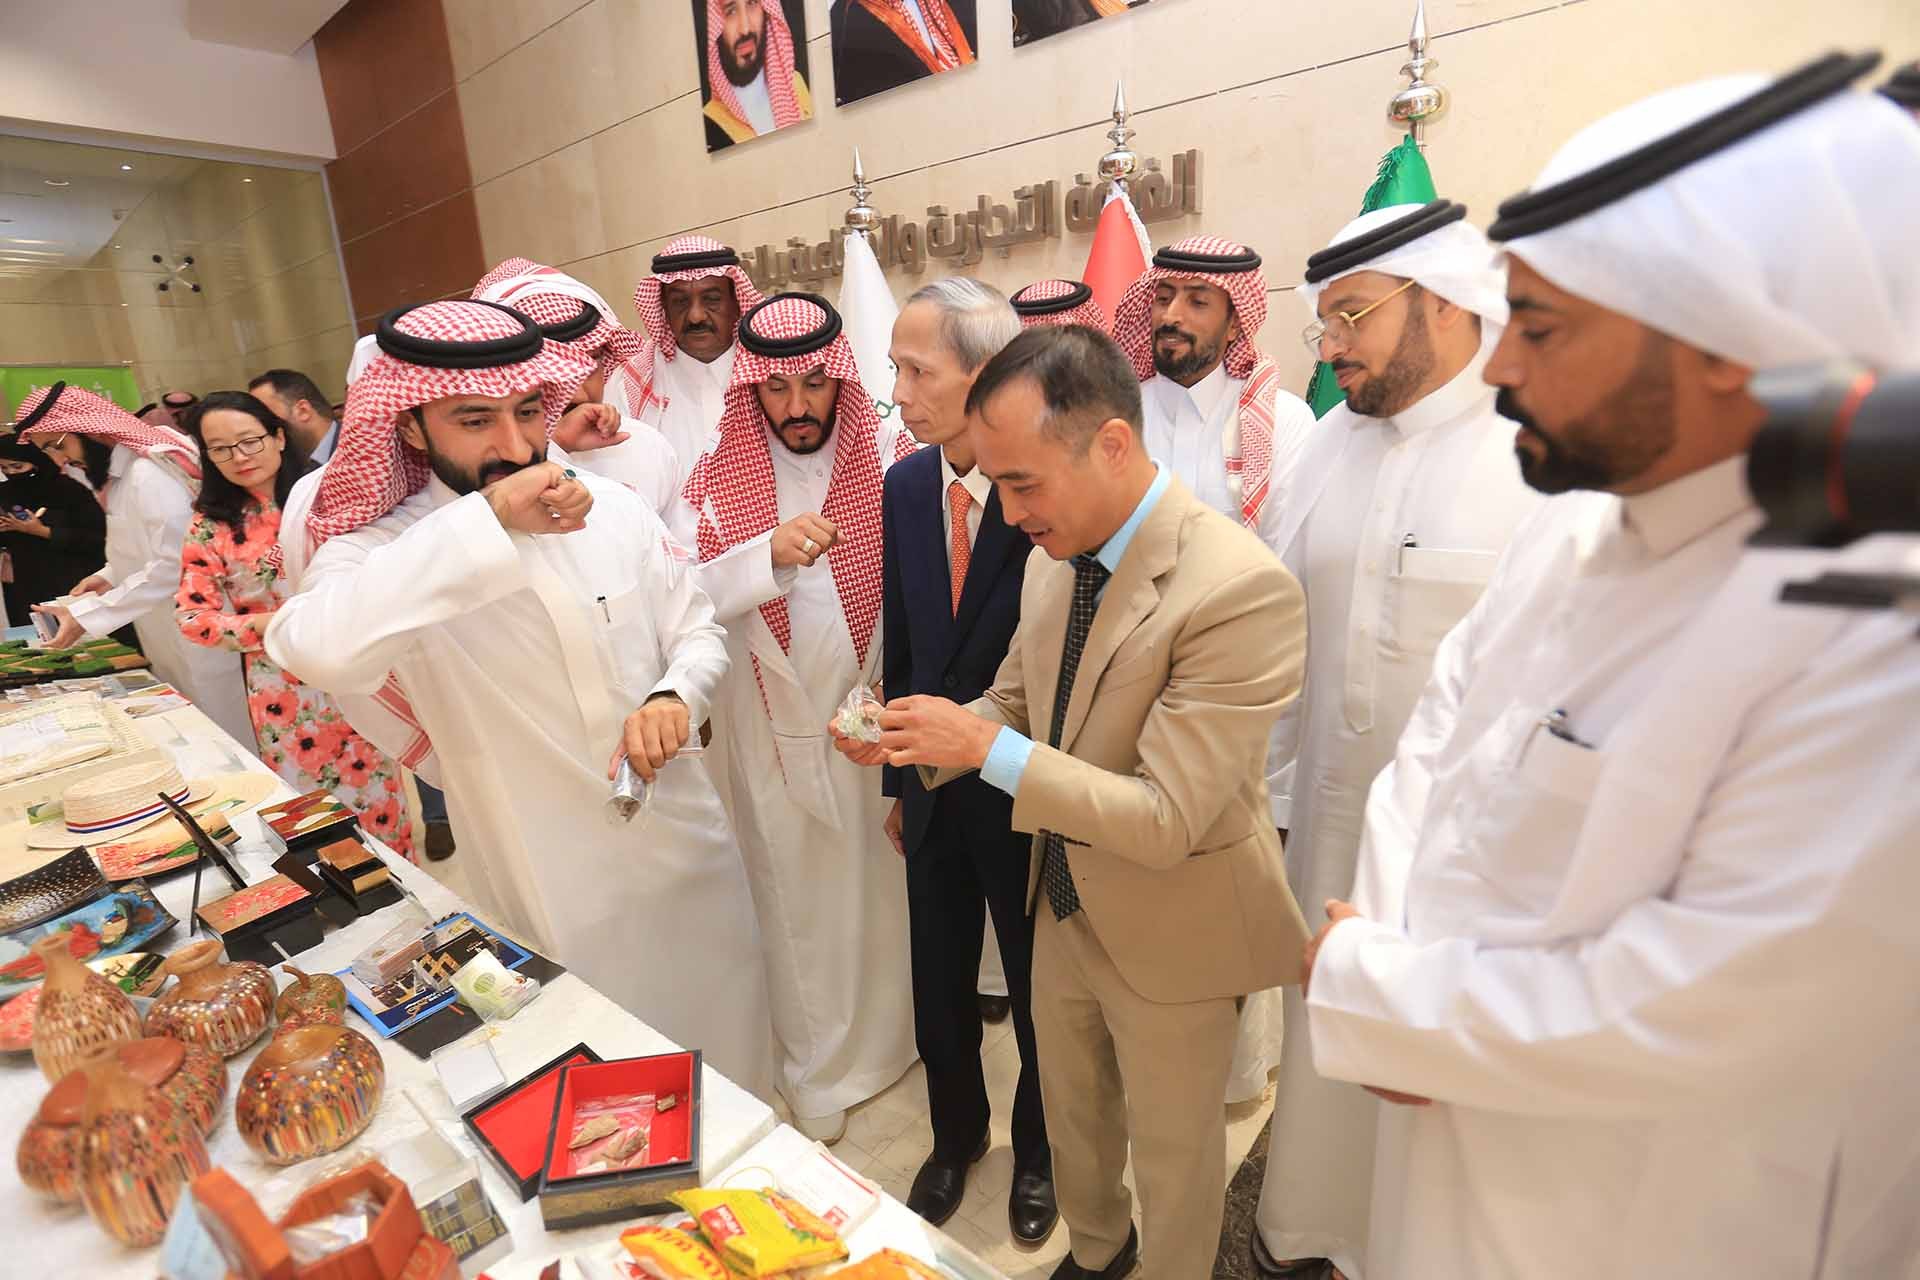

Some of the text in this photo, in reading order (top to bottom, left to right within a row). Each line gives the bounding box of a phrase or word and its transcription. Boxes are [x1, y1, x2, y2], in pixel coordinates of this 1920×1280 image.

[926, 179, 1061, 267] التجارية
[1065, 149, 1202, 234] الغة
[788, 216, 927, 291] والاعية
